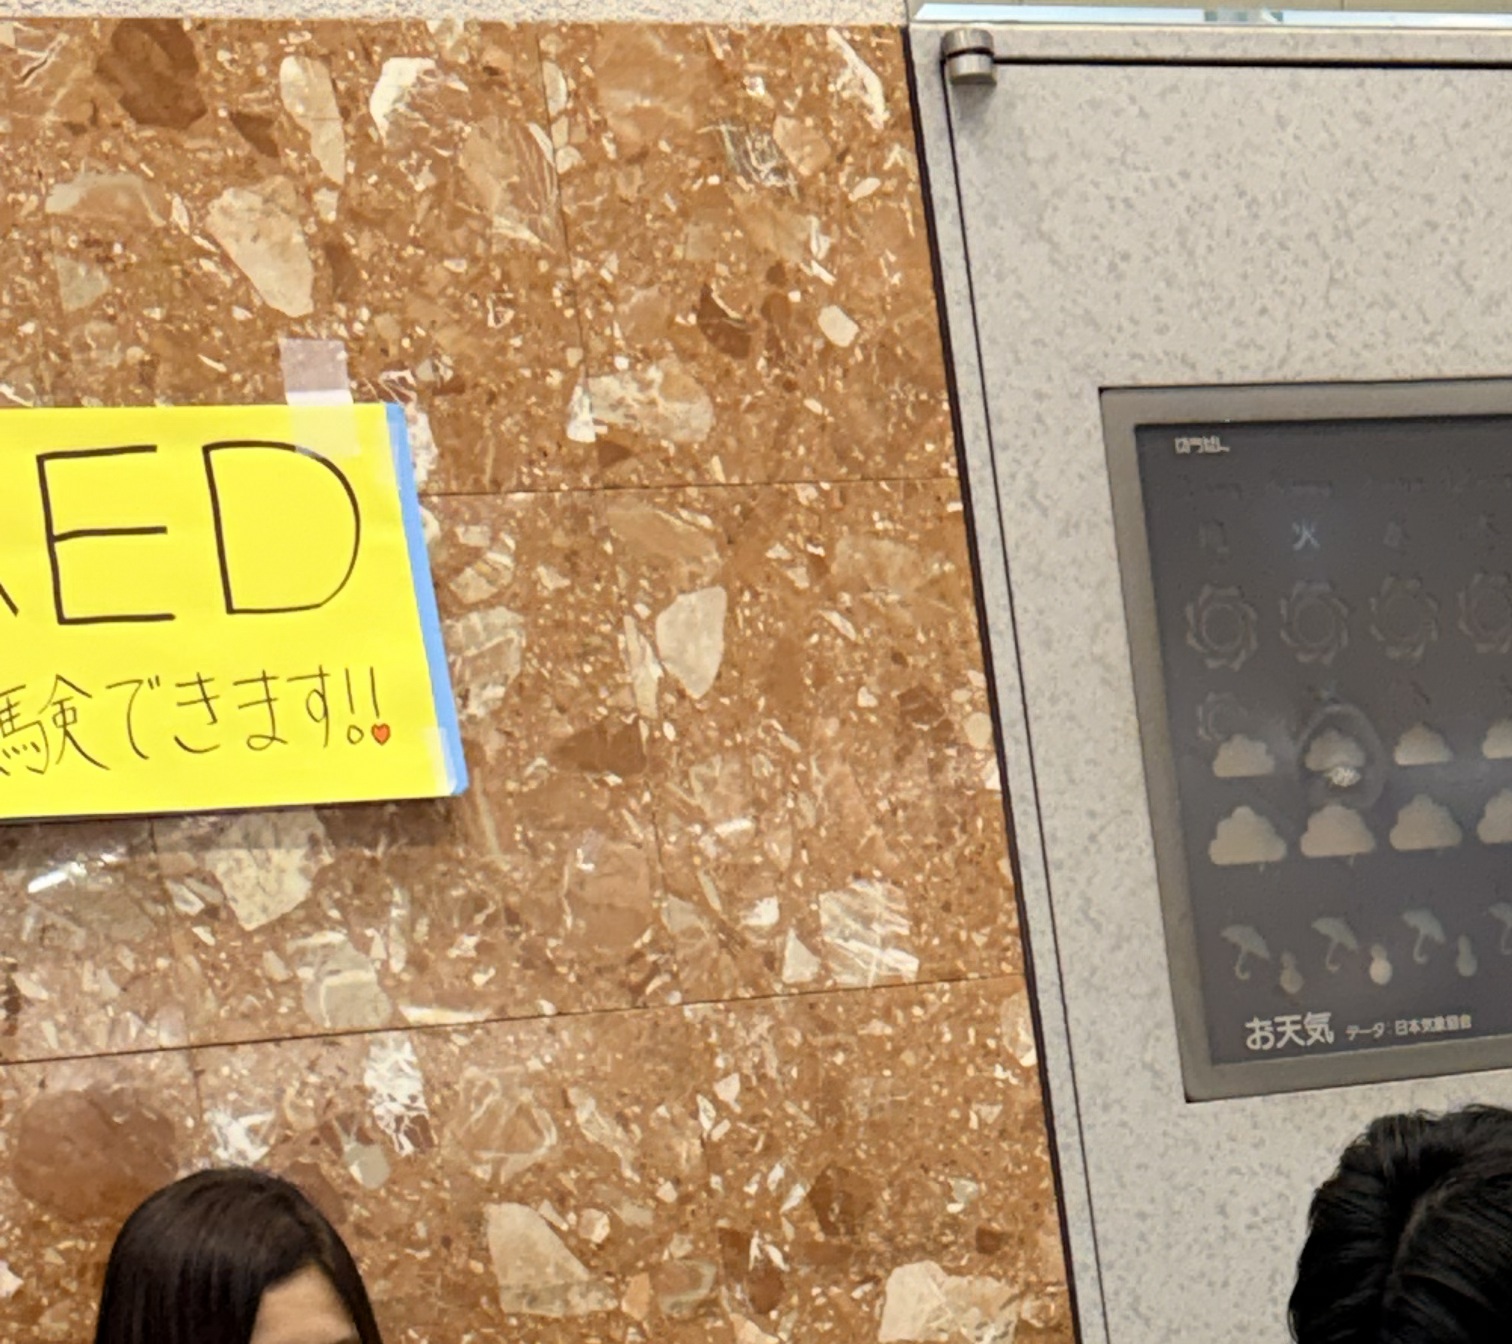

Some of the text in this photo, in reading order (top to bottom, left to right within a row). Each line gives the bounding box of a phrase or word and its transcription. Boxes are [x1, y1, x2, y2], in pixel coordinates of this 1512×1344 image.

[0, 440, 361, 624] ED
[0, 664, 391, 776] 験できます!!
[1245, 1012, 1334, 1050] お天気
